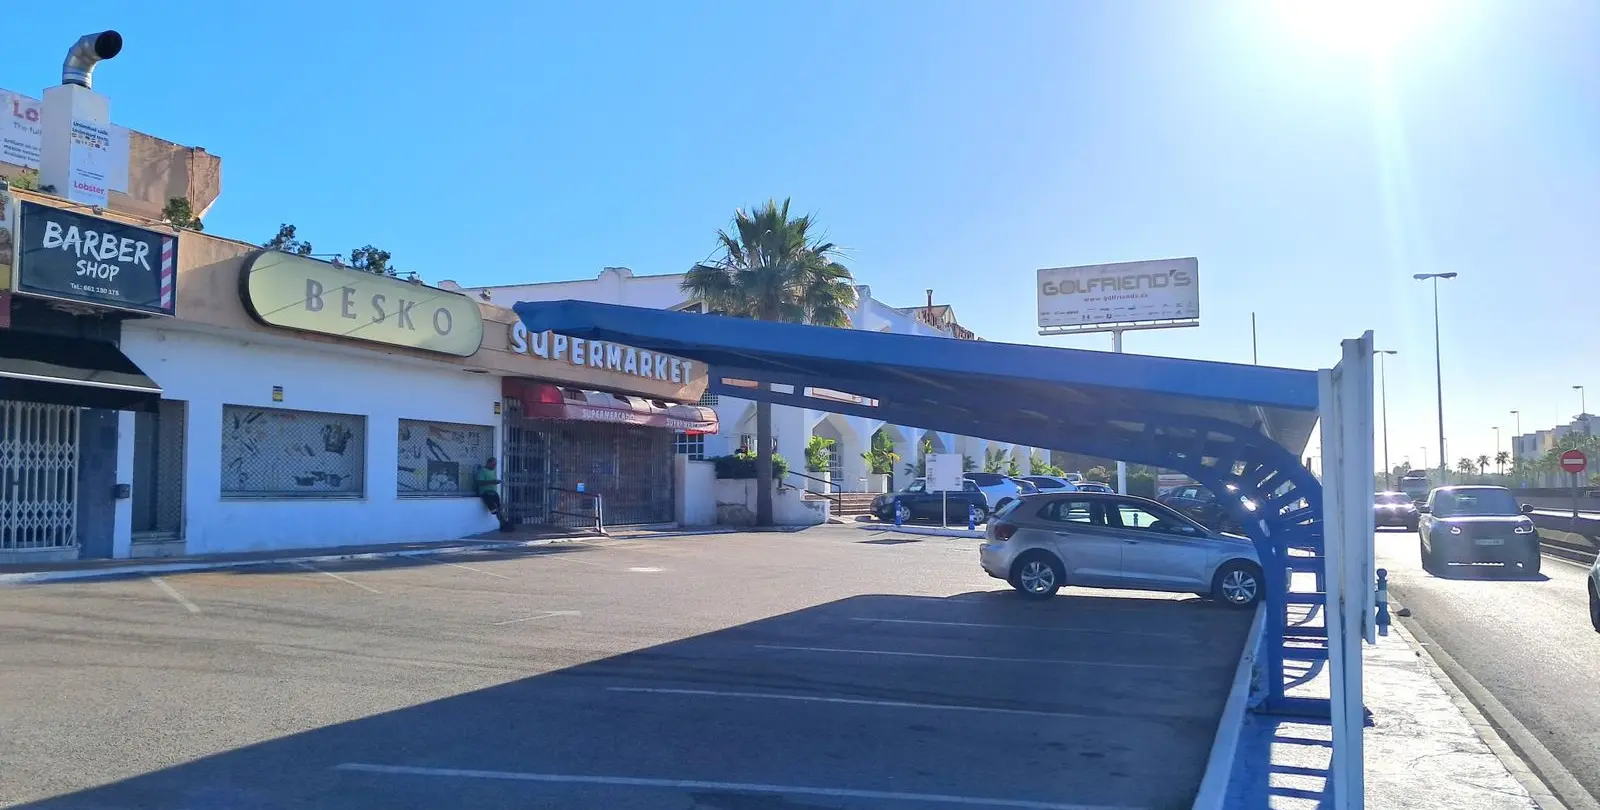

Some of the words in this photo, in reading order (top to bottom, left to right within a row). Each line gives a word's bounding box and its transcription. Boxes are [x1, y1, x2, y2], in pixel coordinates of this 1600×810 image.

[43, 221, 150, 271] BARBER
[76, 259, 120, 282] SHOP
[1042, 269, 1191, 296] GOLFRIEND'S
[304, 278, 453, 336] BESKO
[512, 320, 692, 385] SUPERMARKET
[582, 408, 636, 421] SUPERMERCADO
